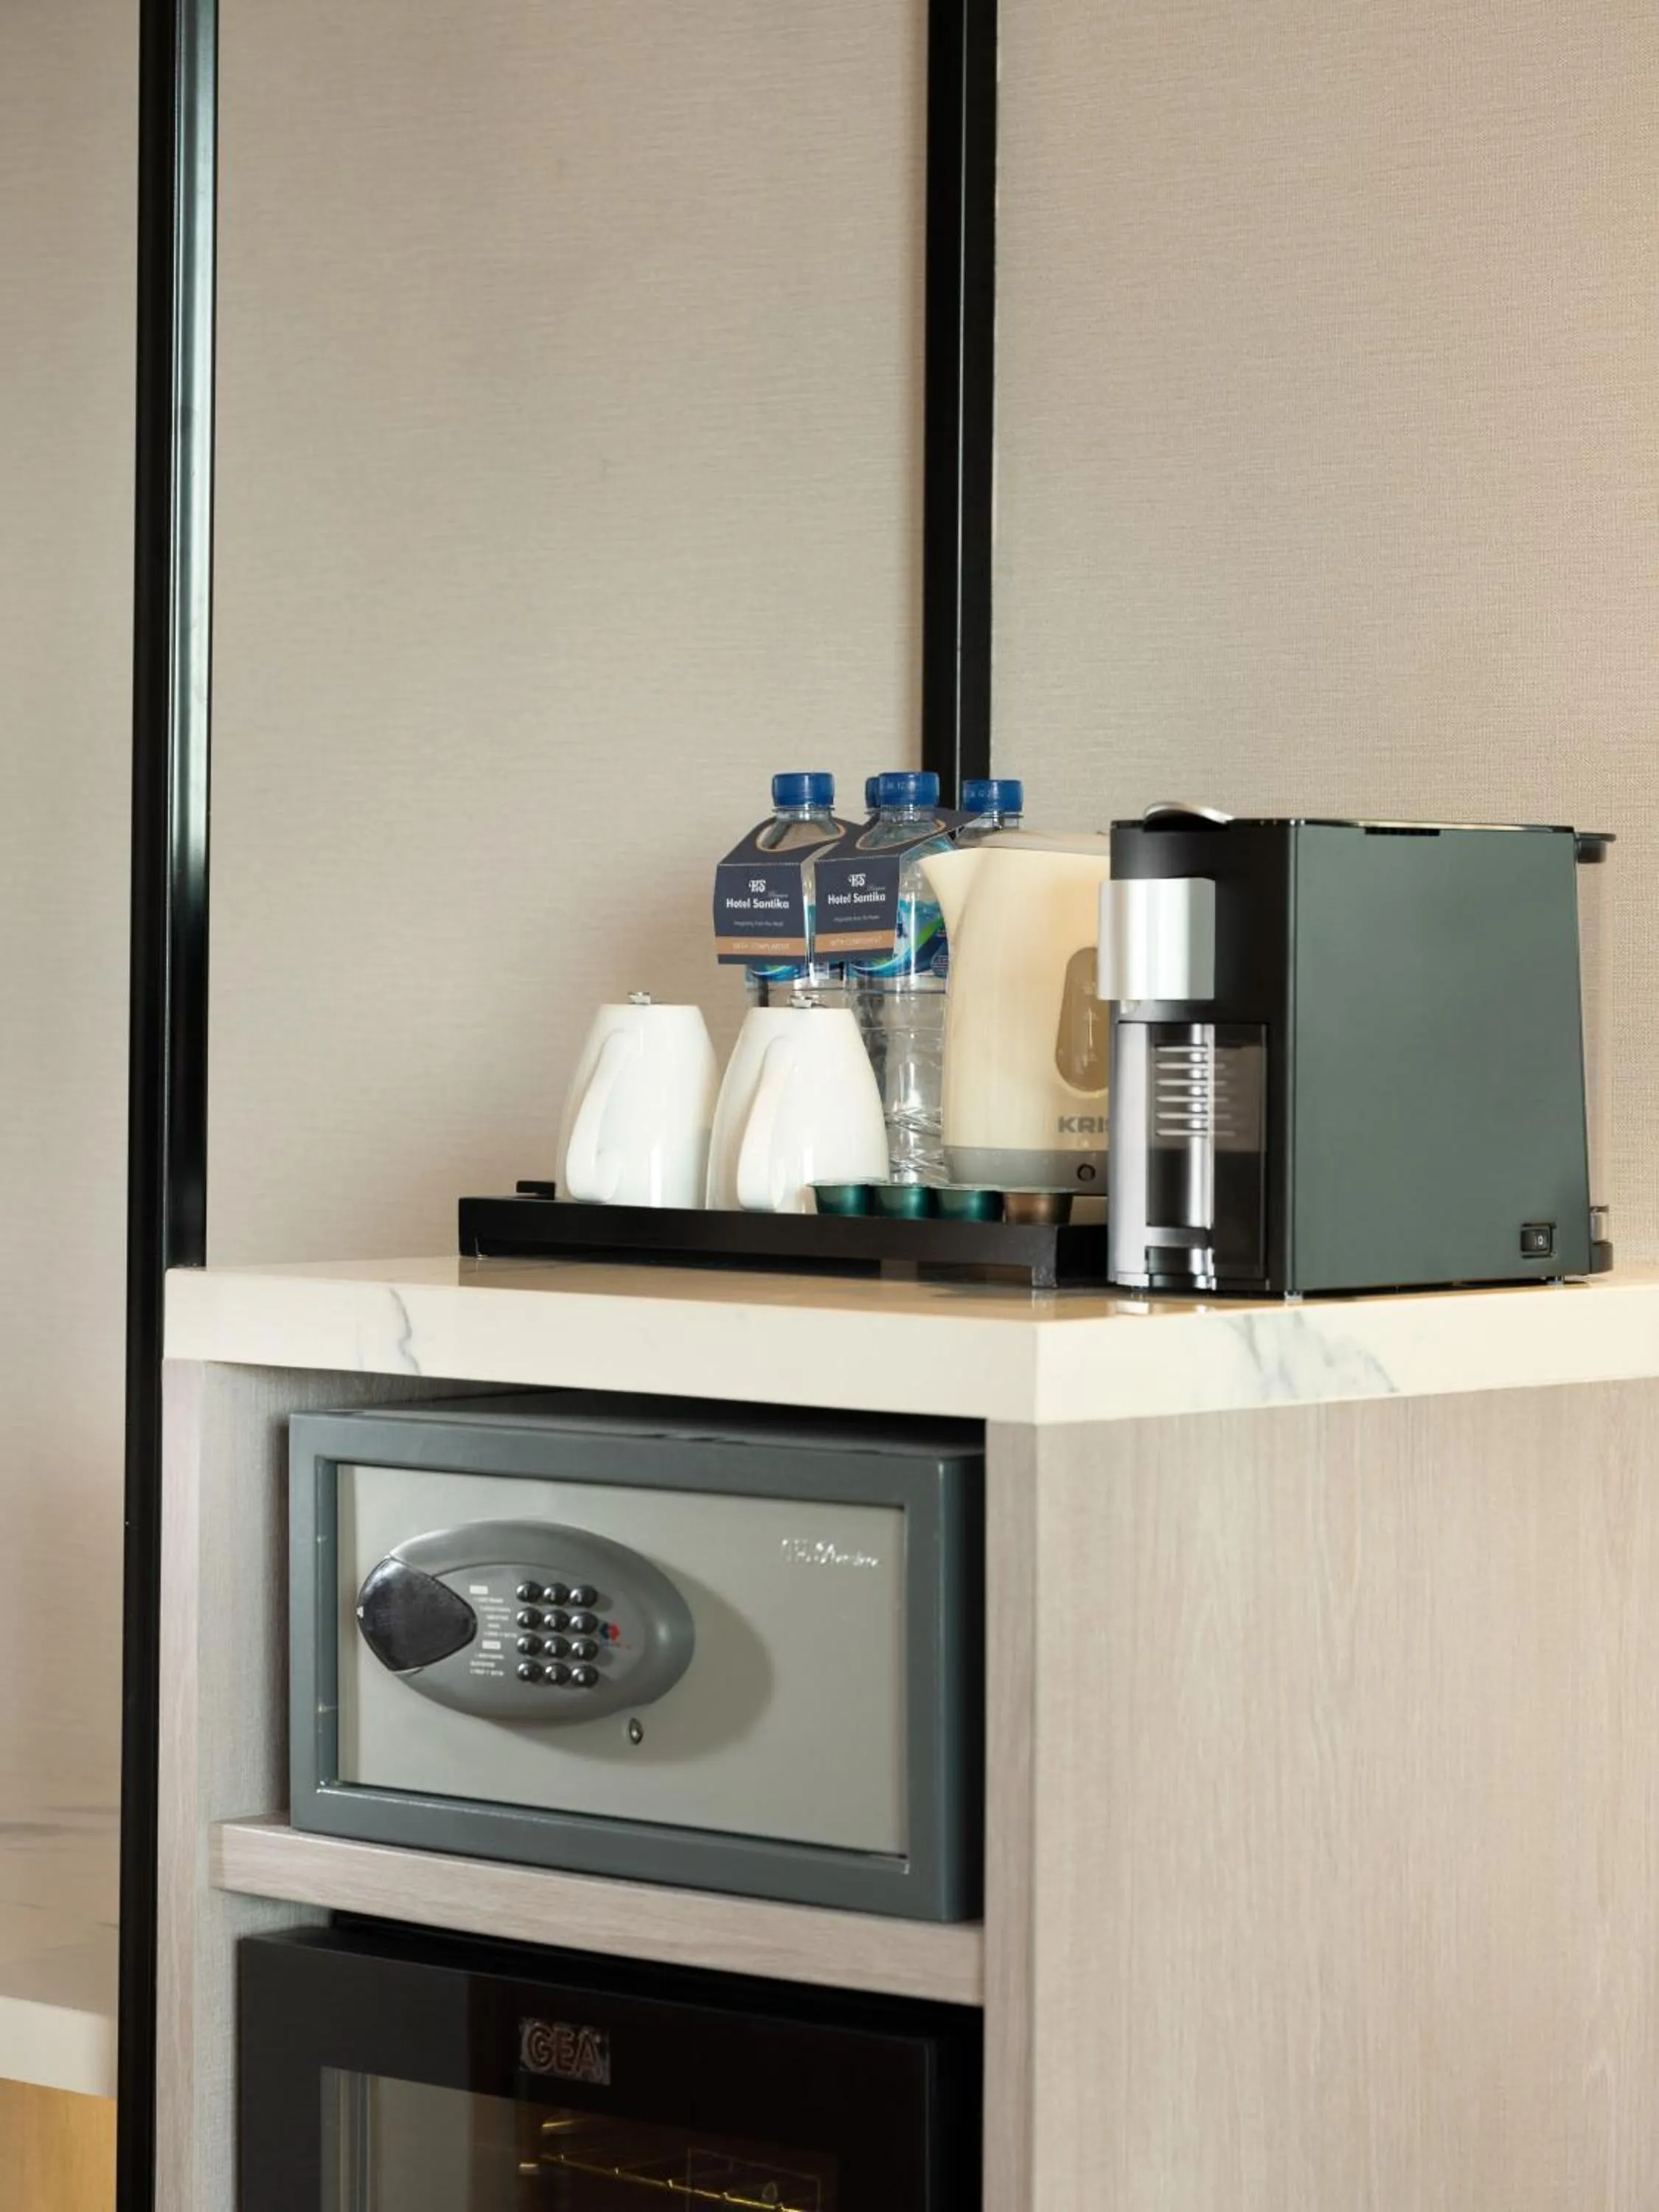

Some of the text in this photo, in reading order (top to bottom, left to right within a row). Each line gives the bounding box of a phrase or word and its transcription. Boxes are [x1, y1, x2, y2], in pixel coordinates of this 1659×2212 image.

[726, 898, 790, 908] Hotel Santika
[828, 891, 886, 905] Hotel Santika
[1058, 1116, 1109, 1133] KRI
[522, 2023, 603, 2079] GEA
